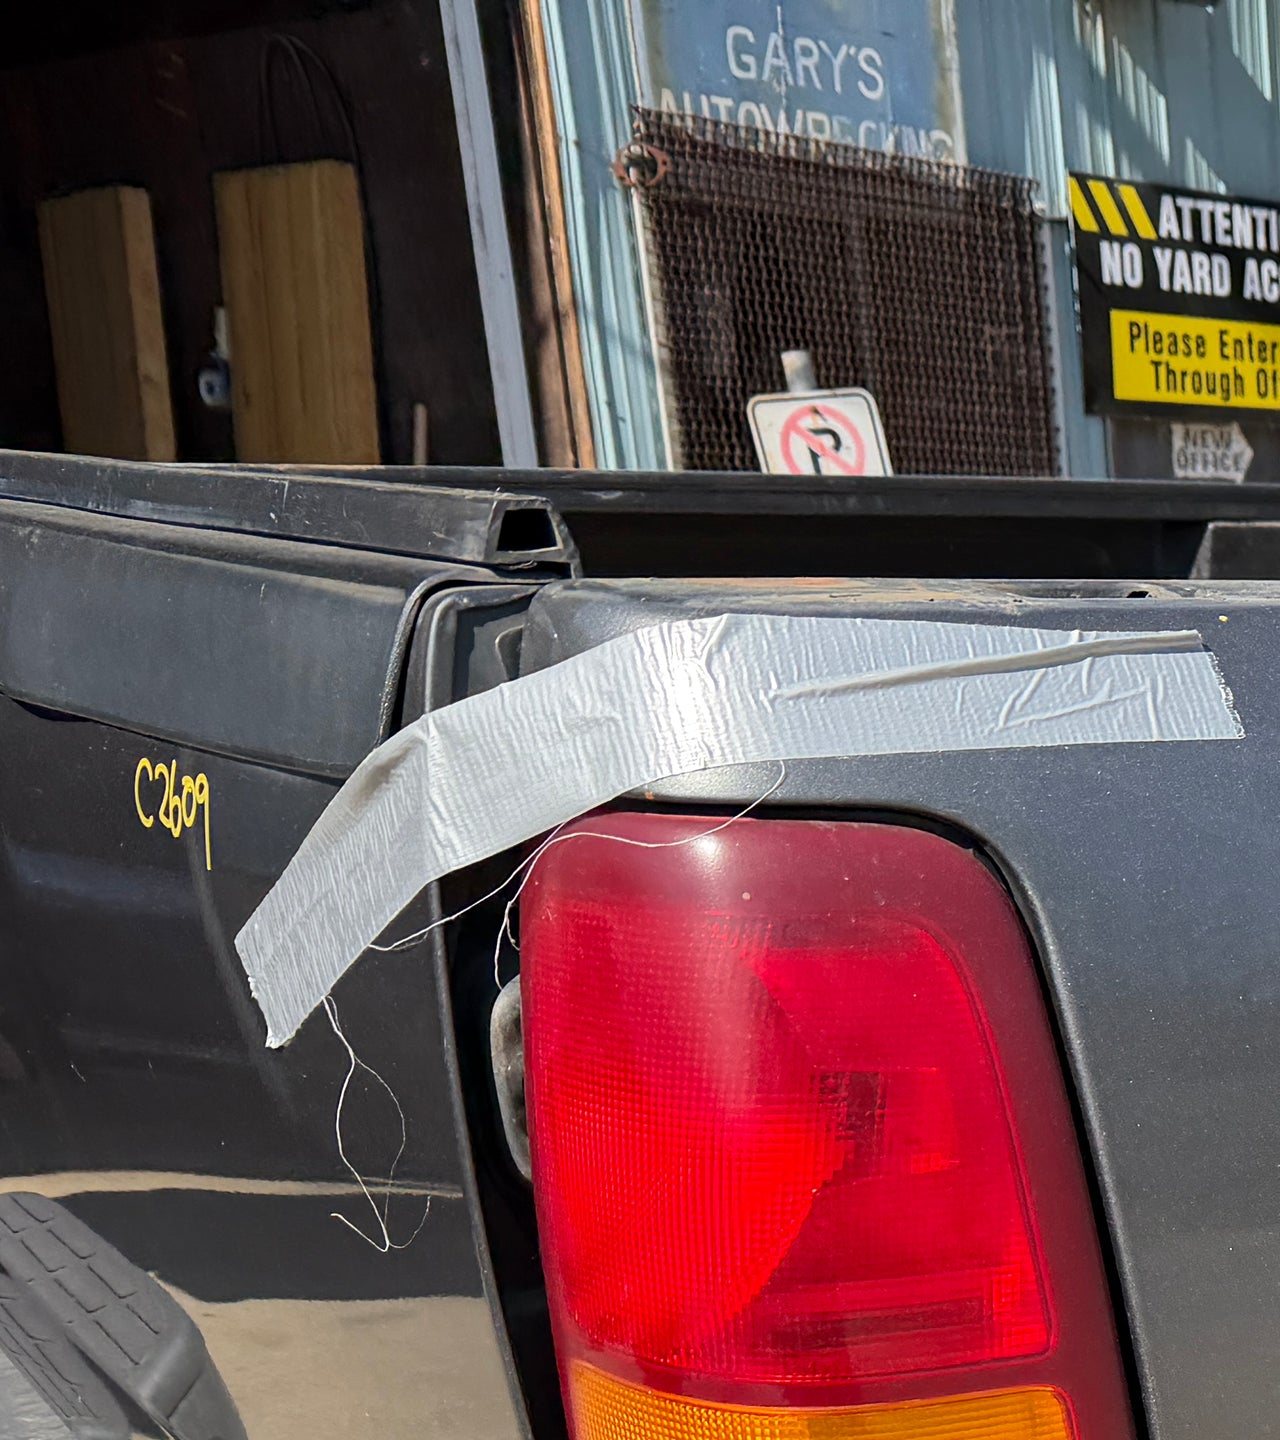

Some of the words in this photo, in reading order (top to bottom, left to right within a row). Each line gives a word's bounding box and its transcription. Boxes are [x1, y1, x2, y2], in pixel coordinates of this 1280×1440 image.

[725, 26, 884, 101] GARY'S
[1100, 240, 1143, 289] NO
[1152, 246, 1232, 298] YARD
[1129, 321, 1207, 359] Please
[1219, 329, 1279, 362] Enter
[1150, 360, 1246, 402] Through
[134, 757, 213, 871] C2609
